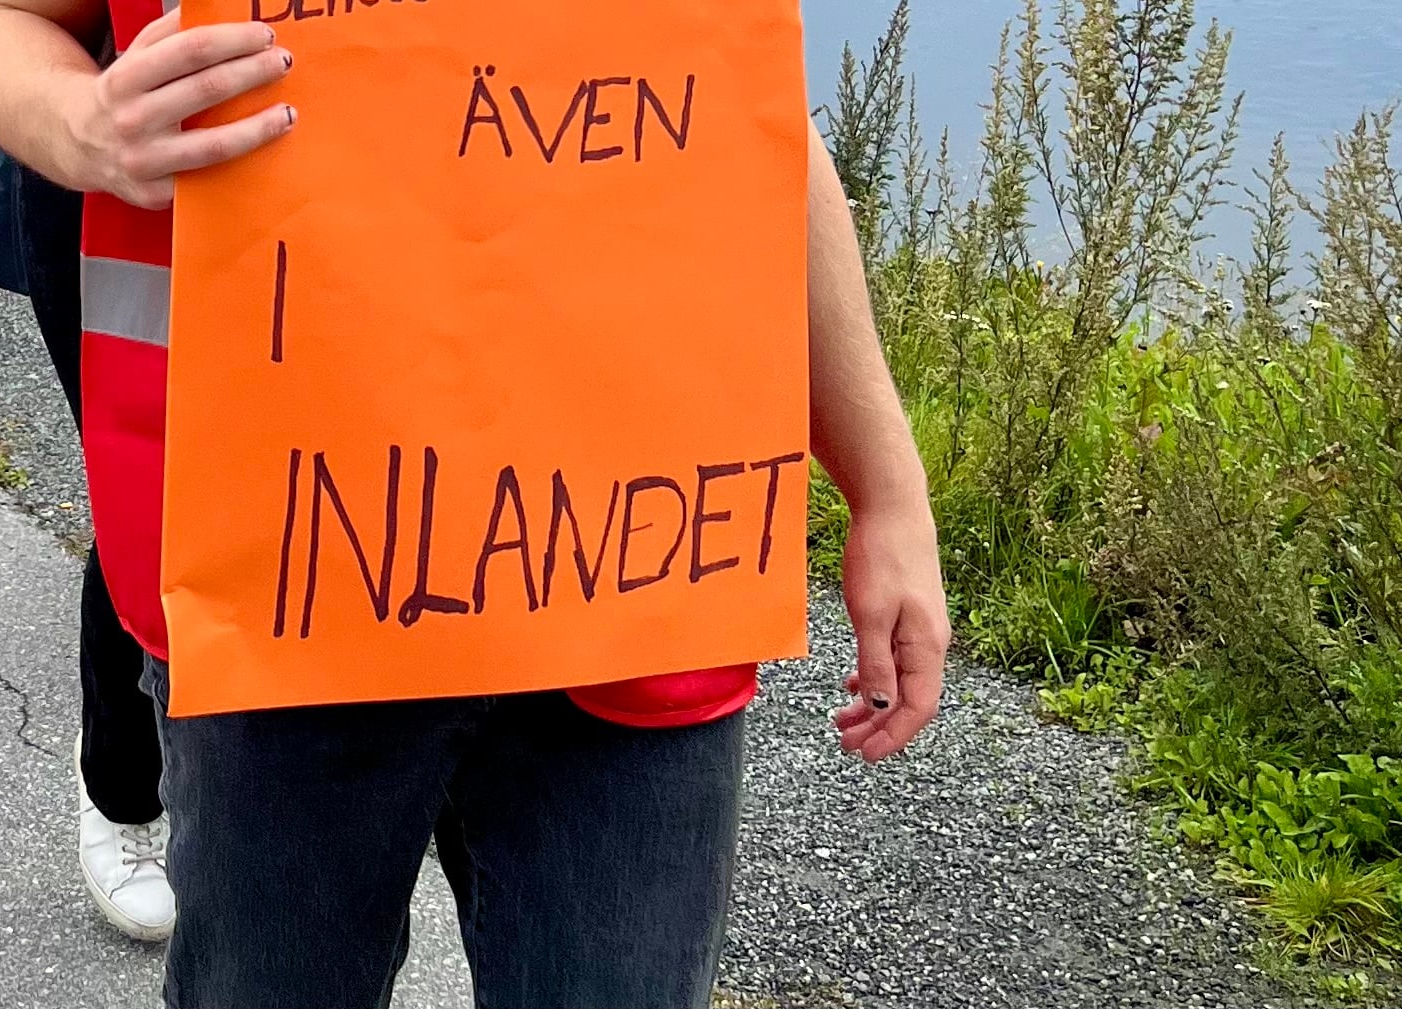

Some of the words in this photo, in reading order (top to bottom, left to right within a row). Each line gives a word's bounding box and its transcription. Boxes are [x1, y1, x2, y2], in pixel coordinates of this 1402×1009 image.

[458, 65, 695, 163] ÄVEN
[270, 240, 286, 363] I
[273, 444, 805, 639] INLANDET
